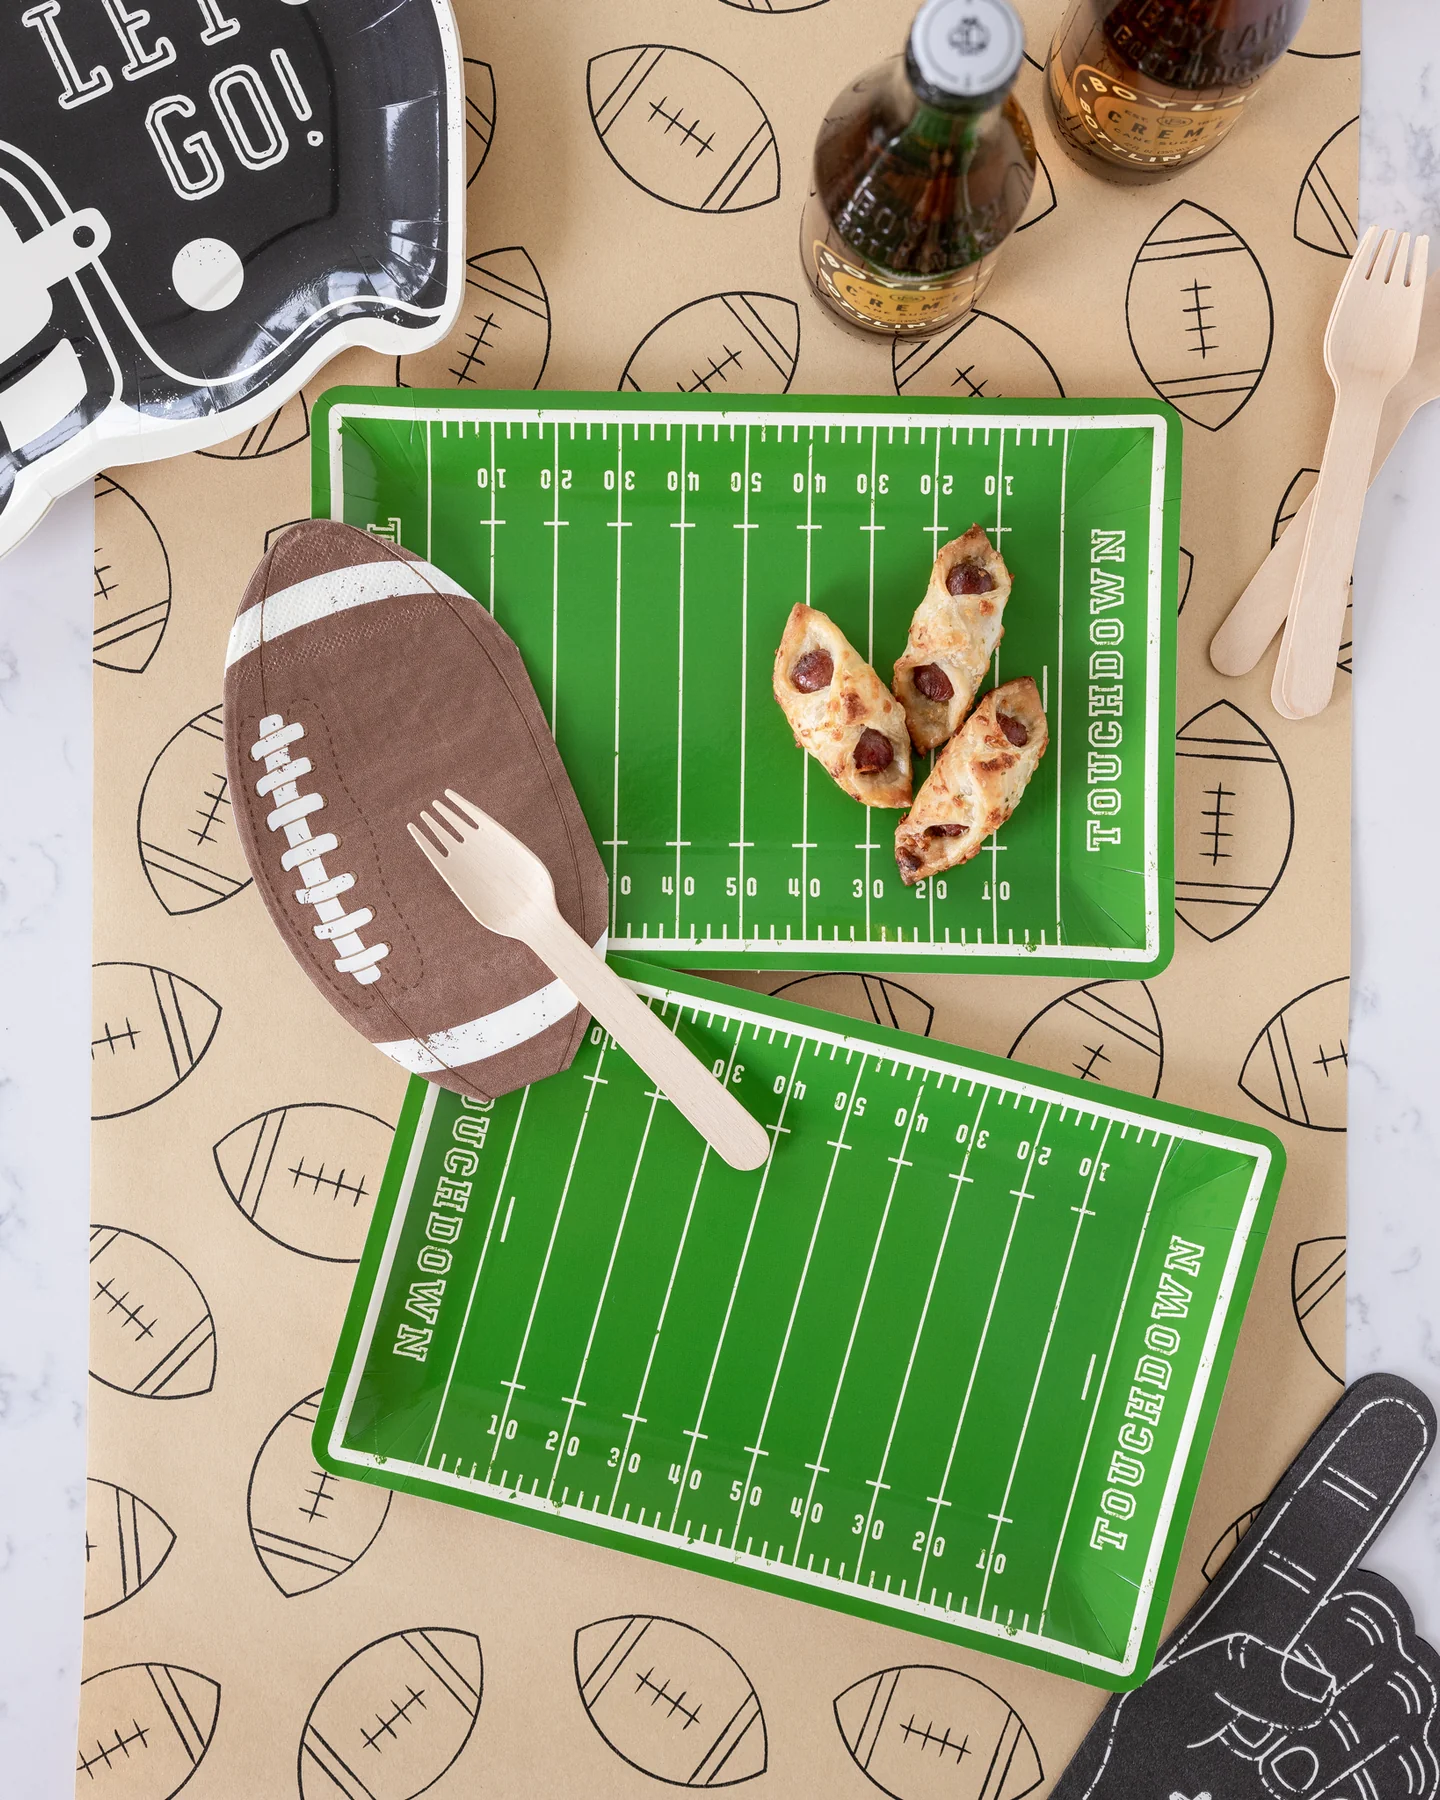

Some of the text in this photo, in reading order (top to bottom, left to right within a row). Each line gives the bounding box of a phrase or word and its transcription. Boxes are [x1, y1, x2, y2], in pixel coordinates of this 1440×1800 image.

[145, 48, 324, 200] GO!
[1086, 529, 1126, 852] TOUCHDOWN
[620, 875, 1011, 901] 0 40 50 40 30 20 10
[393, 1095, 496, 1363] UCHDOWN
[487, 1414, 1007, 1574] 10 20 30 40 50 40 30 20 10
[1089, 1235, 1205, 1550] TOUCHDOWN
